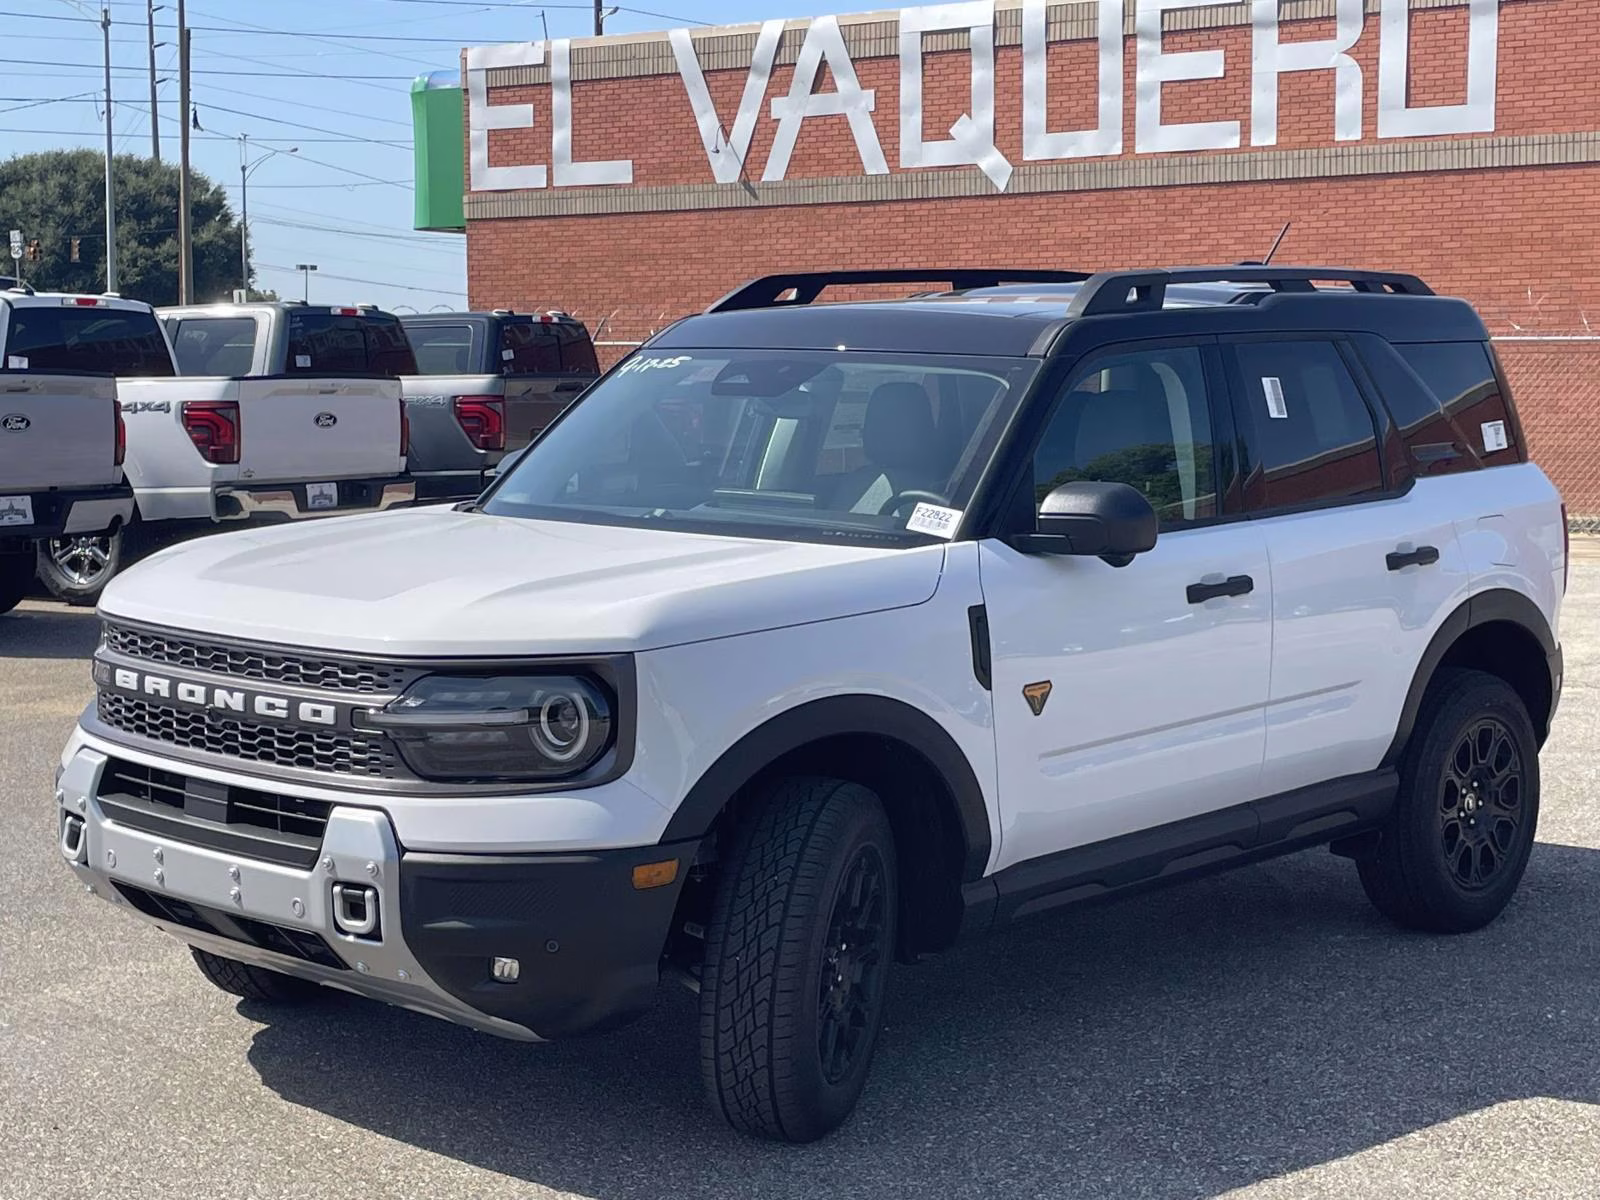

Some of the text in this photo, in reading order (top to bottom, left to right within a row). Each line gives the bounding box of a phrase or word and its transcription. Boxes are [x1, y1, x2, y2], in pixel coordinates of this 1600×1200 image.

[467, 0, 1499, 193] EL VAQUERO
[4, 415, 29, 431] Ford
[915, 506, 953, 523] F22822
[115, 668, 336, 725] BRONCO
